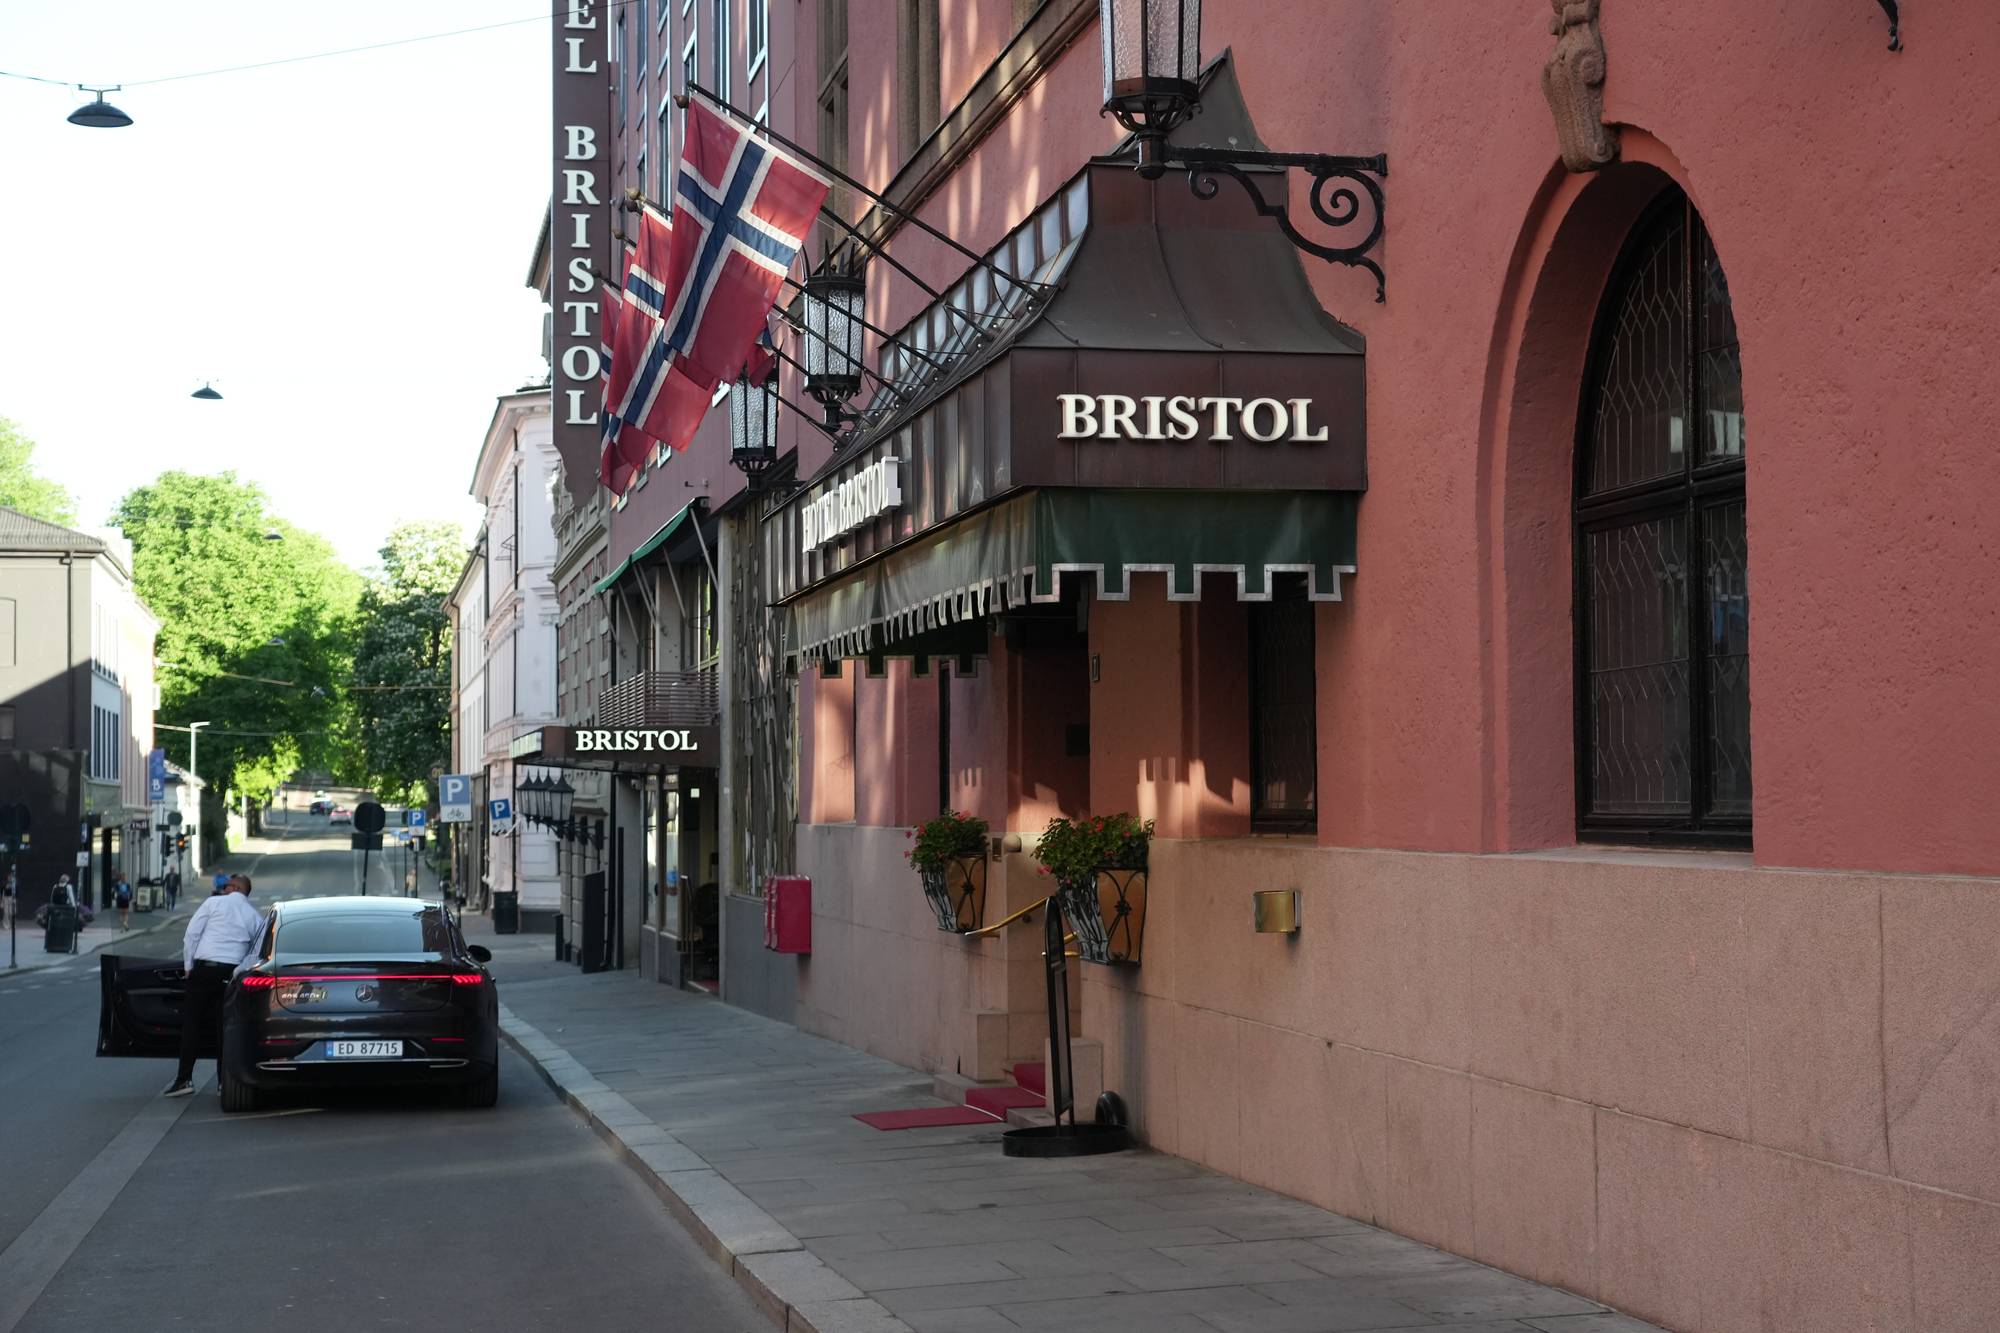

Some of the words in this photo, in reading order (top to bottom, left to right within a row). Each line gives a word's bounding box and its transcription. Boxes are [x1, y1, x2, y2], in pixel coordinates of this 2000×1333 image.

[562, 125, 600, 424] BRISTOL
[1056, 393, 1329, 442] BRISTOL
[802, 489, 839, 553] HOTEL
[839, 456, 901, 533] BRISTOL
[575, 730, 698, 751] BRISTOL
[446, 778, 463, 802] P
[411, 812, 422, 825] P
[493, 801, 505, 817] P
[338, 1043, 354, 1055] ED
[360, 1043, 398, 1055] 87715
